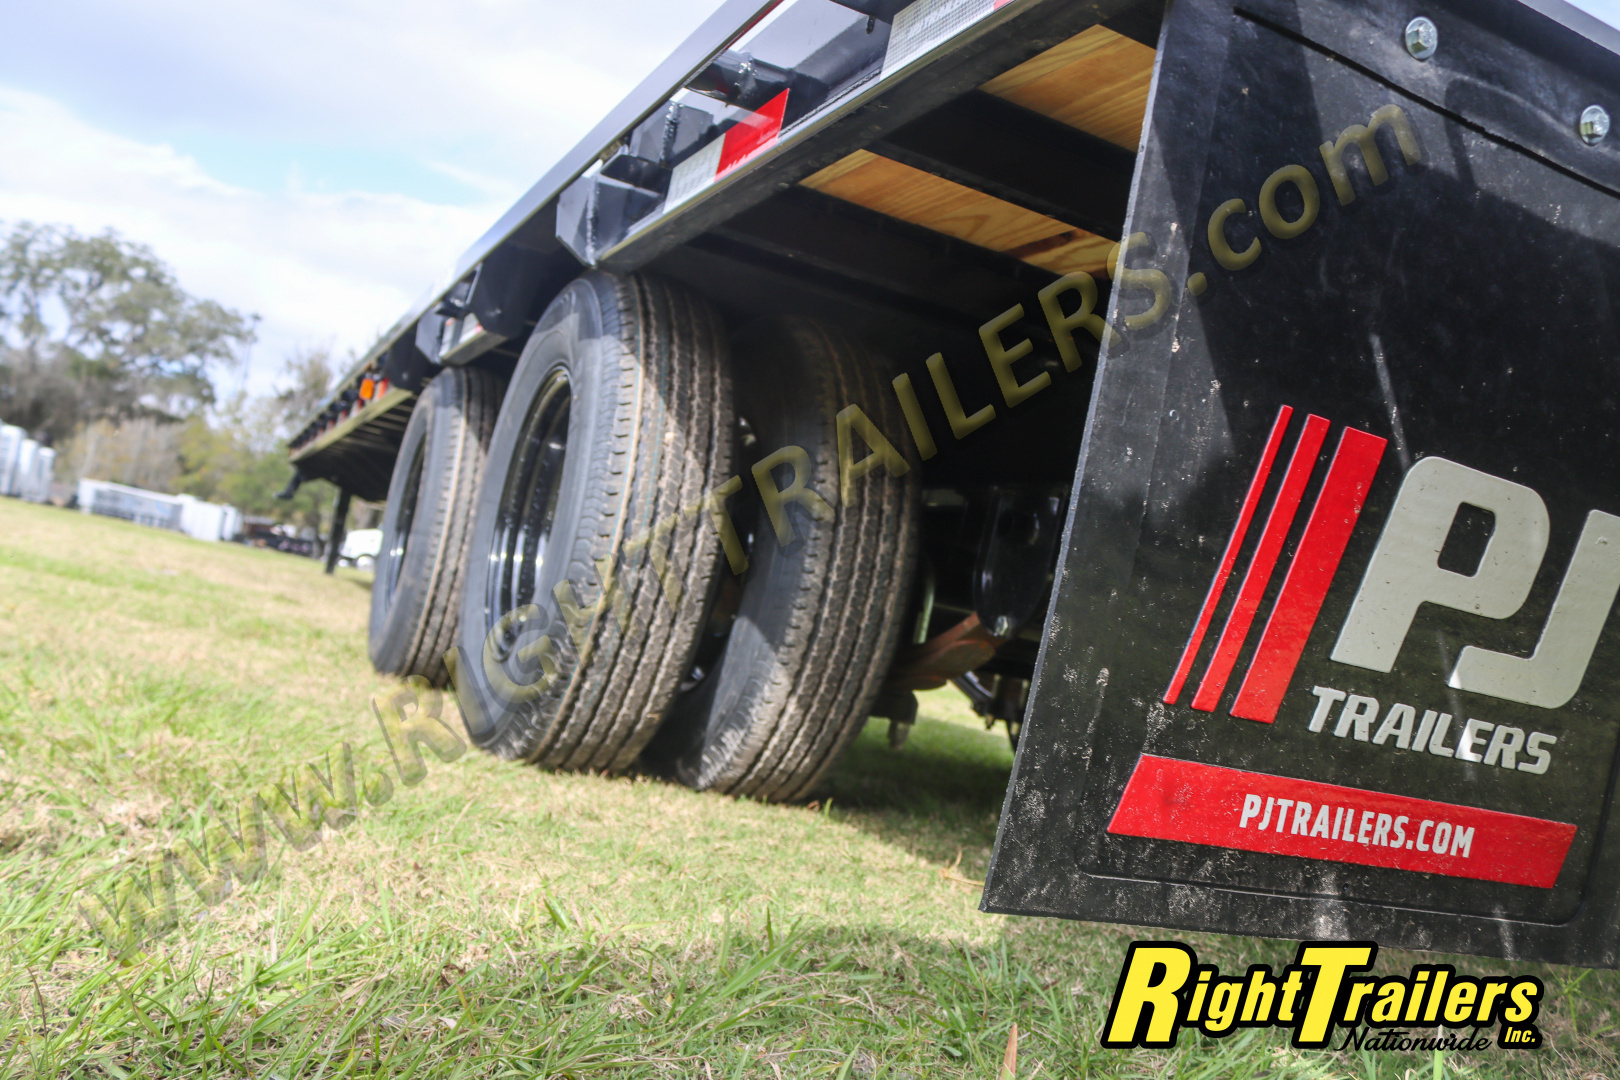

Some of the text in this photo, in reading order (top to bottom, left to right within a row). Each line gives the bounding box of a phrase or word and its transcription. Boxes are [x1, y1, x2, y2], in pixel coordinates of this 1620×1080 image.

[1329, 455, 1620, 710] PJ
[1308, 685, 1557, 775] TRAILERS
[1239, 793, 1475, 858] PJTRAILERS.COM
